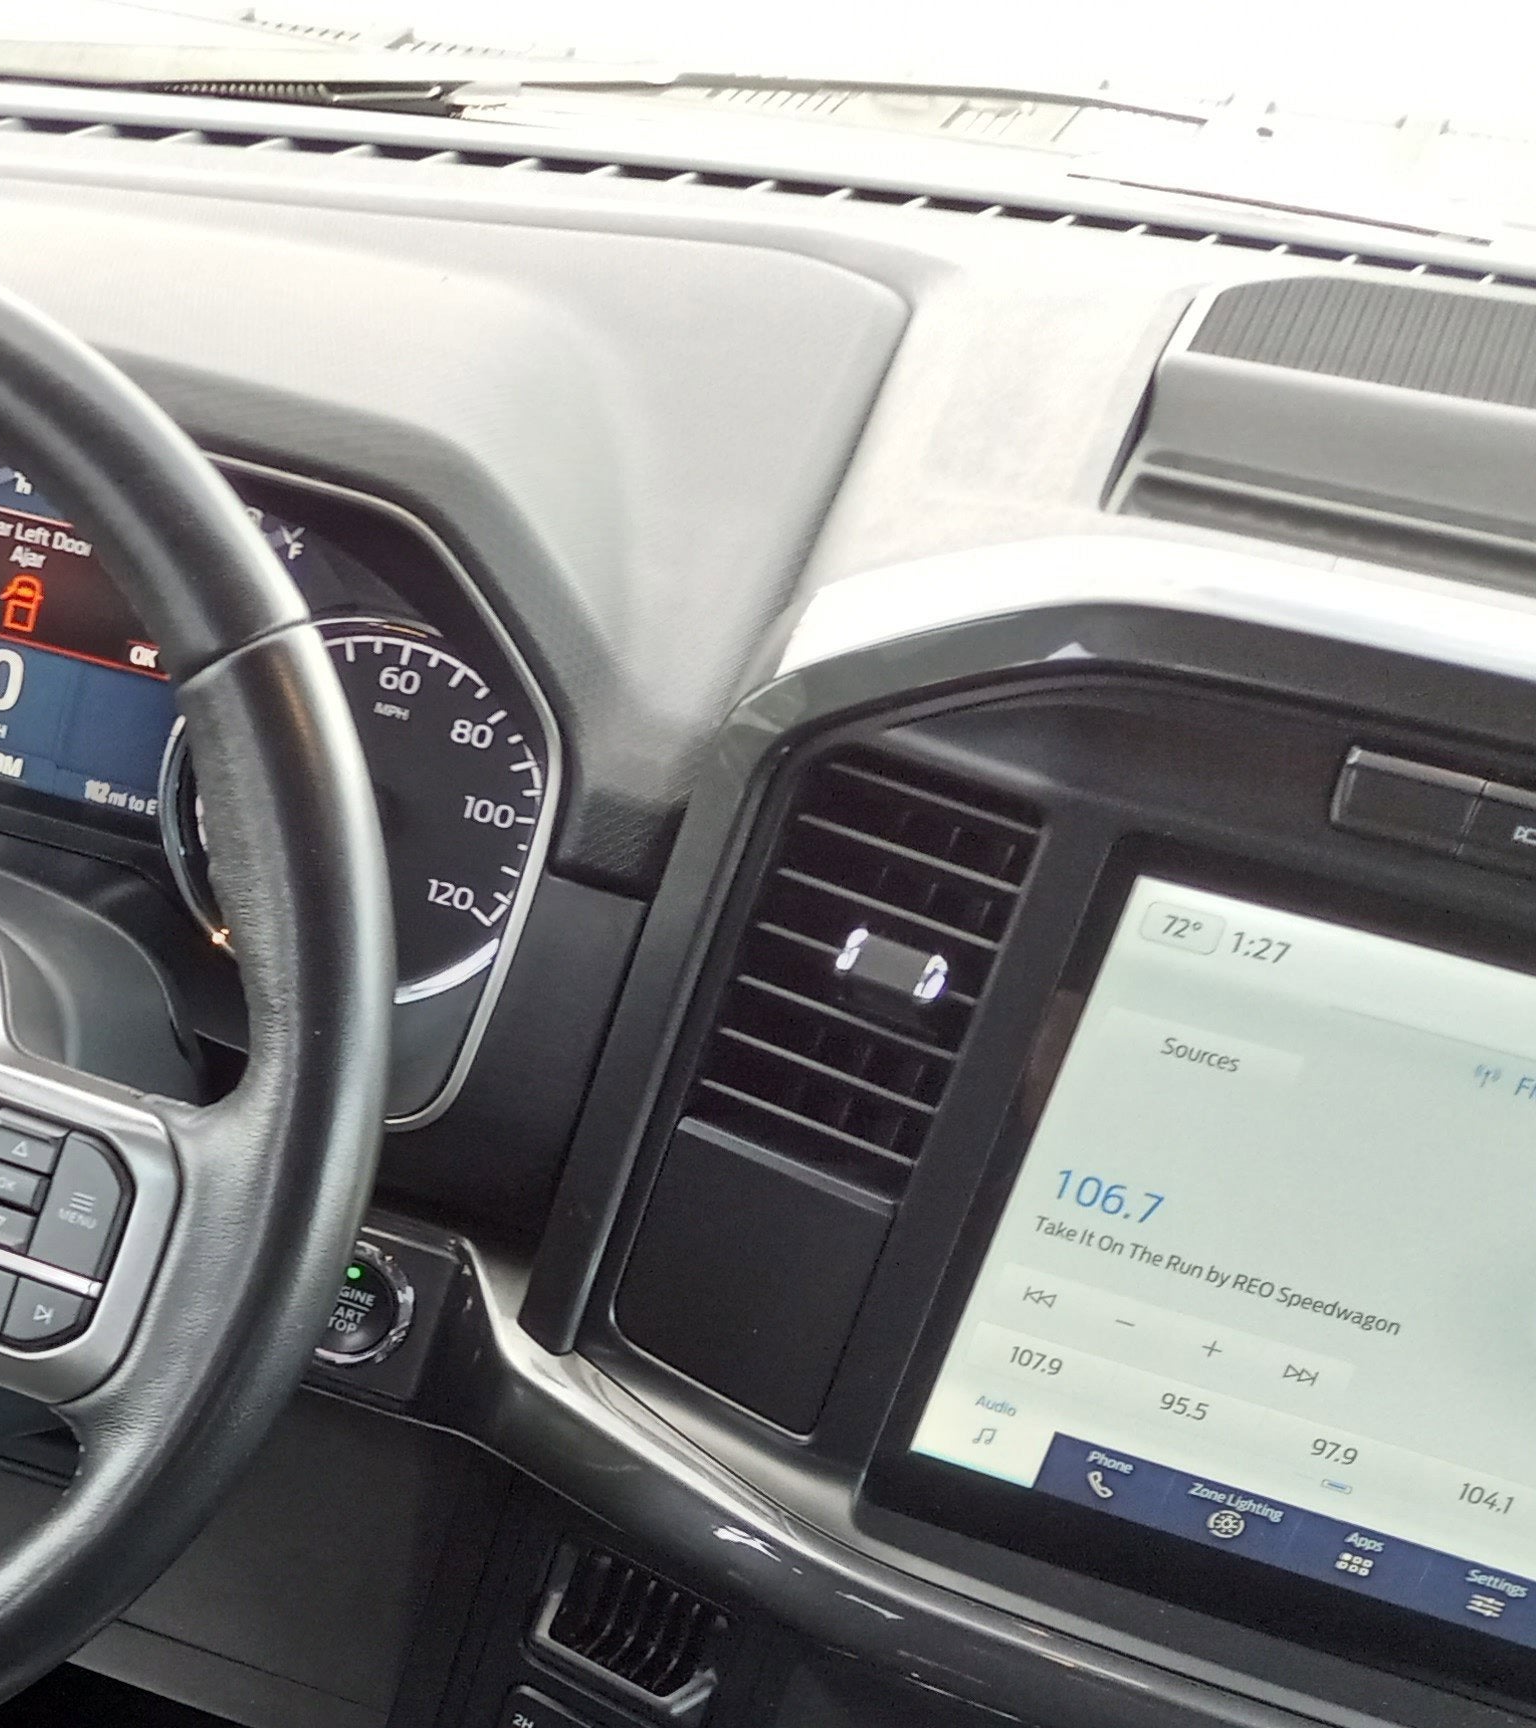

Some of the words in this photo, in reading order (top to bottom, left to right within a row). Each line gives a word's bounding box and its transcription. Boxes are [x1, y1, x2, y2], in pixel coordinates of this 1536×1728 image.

[14, 522, 51, 547] Left
[9, 545, 47, 569] Ajar
[288, 541, 305, 560] F
[129, 645, 158, 669] OK
[378, 667, 422, 696] 60
[373, 701, 411, 722] MPH
[450, 719, 495, 750] 80
[462, 794, 516, 829] 100
[426, 878, 476, 911] 120
[1160, 914, 1203, 940] 72°
[1230, 931, 1292, 965] 1:27
[1160, 1036, 1241, 1074] Sources
[1055, 1169, 1165, 1224] 106.7
[58, 1207, 99, 1231] MENU
[1034, 1214, 1078, 1242] Take
[1079, 1228, 1097, 1247] It
[1097, 1234, 1125, 1257] On
[1128, 1242, 1164, 1268] The
[1165, 1254, 1204, 1281] Run
[1206, 1264, 1231, 1290] by
[1231, 1273, 1275, 1299] REO
[1275, 1286, 1402, 1337] Speedwagon
[338, 1284, 376, 1308] GINE
[327, 1316, 358, 1334] TOP
[334, 1305, 367, 1324] ART
[1008, 1344, 1064, 1377] 107.9
[974, 1394, 1018, 1419] Audio
[1159, 1392, 1209, 1423] 95.5
[1086, 1449, 1135, 1476] Phone
[1310, 1438, 1359, 1466] 97.9
[1187, 1481, 1228, 1506] Zone
[1226, 1491, 1286, 1524] Lighting
[1458, 1482, 1515, 1515] 104.1
[1344, 1531, 1384, 1555] Apps
[1464, 1568, 1528, 1600] Settings
